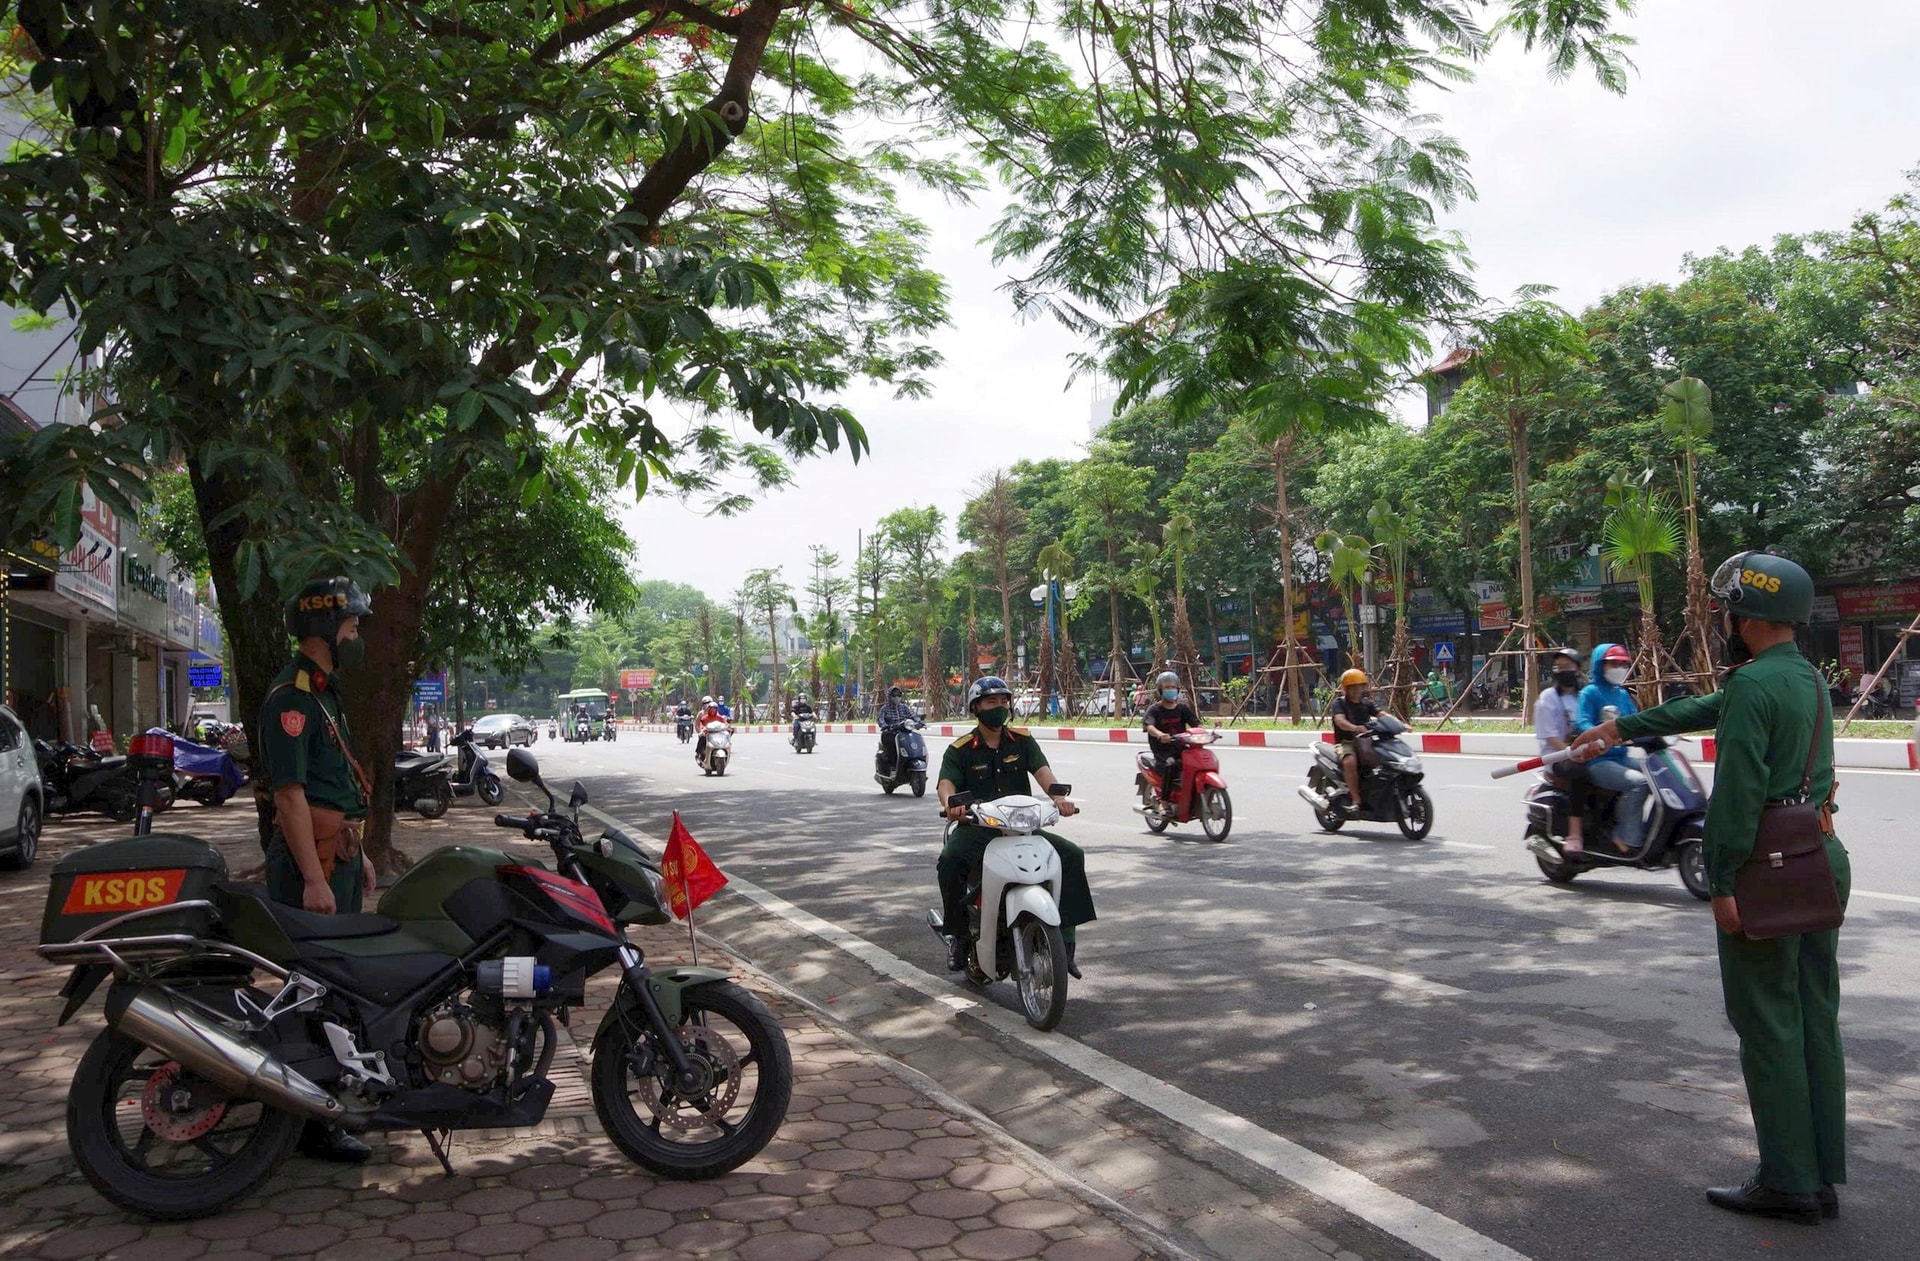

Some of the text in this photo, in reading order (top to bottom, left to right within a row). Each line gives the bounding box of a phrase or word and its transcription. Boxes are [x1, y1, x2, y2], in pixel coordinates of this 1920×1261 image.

[1576, 564, 1593, 580] AX
[1741, 569, 1781, 593] SQS
[84, 877, 166, 906] KSQS
